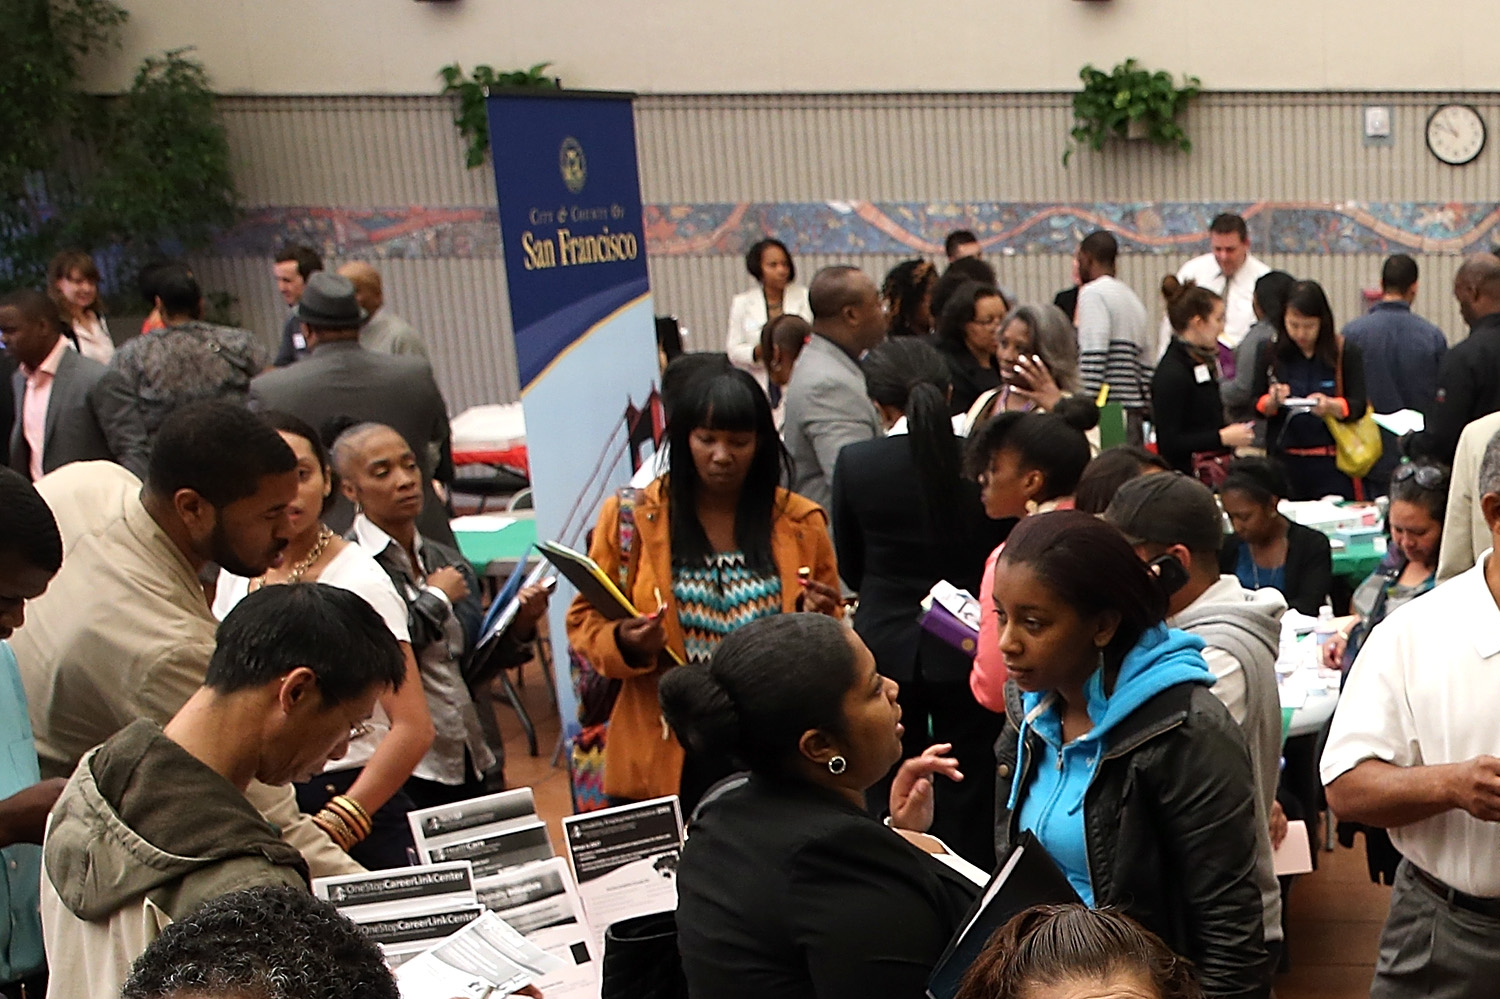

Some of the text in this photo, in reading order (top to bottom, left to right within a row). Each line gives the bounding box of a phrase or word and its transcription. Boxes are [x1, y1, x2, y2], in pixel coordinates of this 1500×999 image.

[557, 206, 569, 223] &
[521, 226, 638, 270] San Francisco
[346, 871, 465, 894] OneStopCareerLinkCenter
